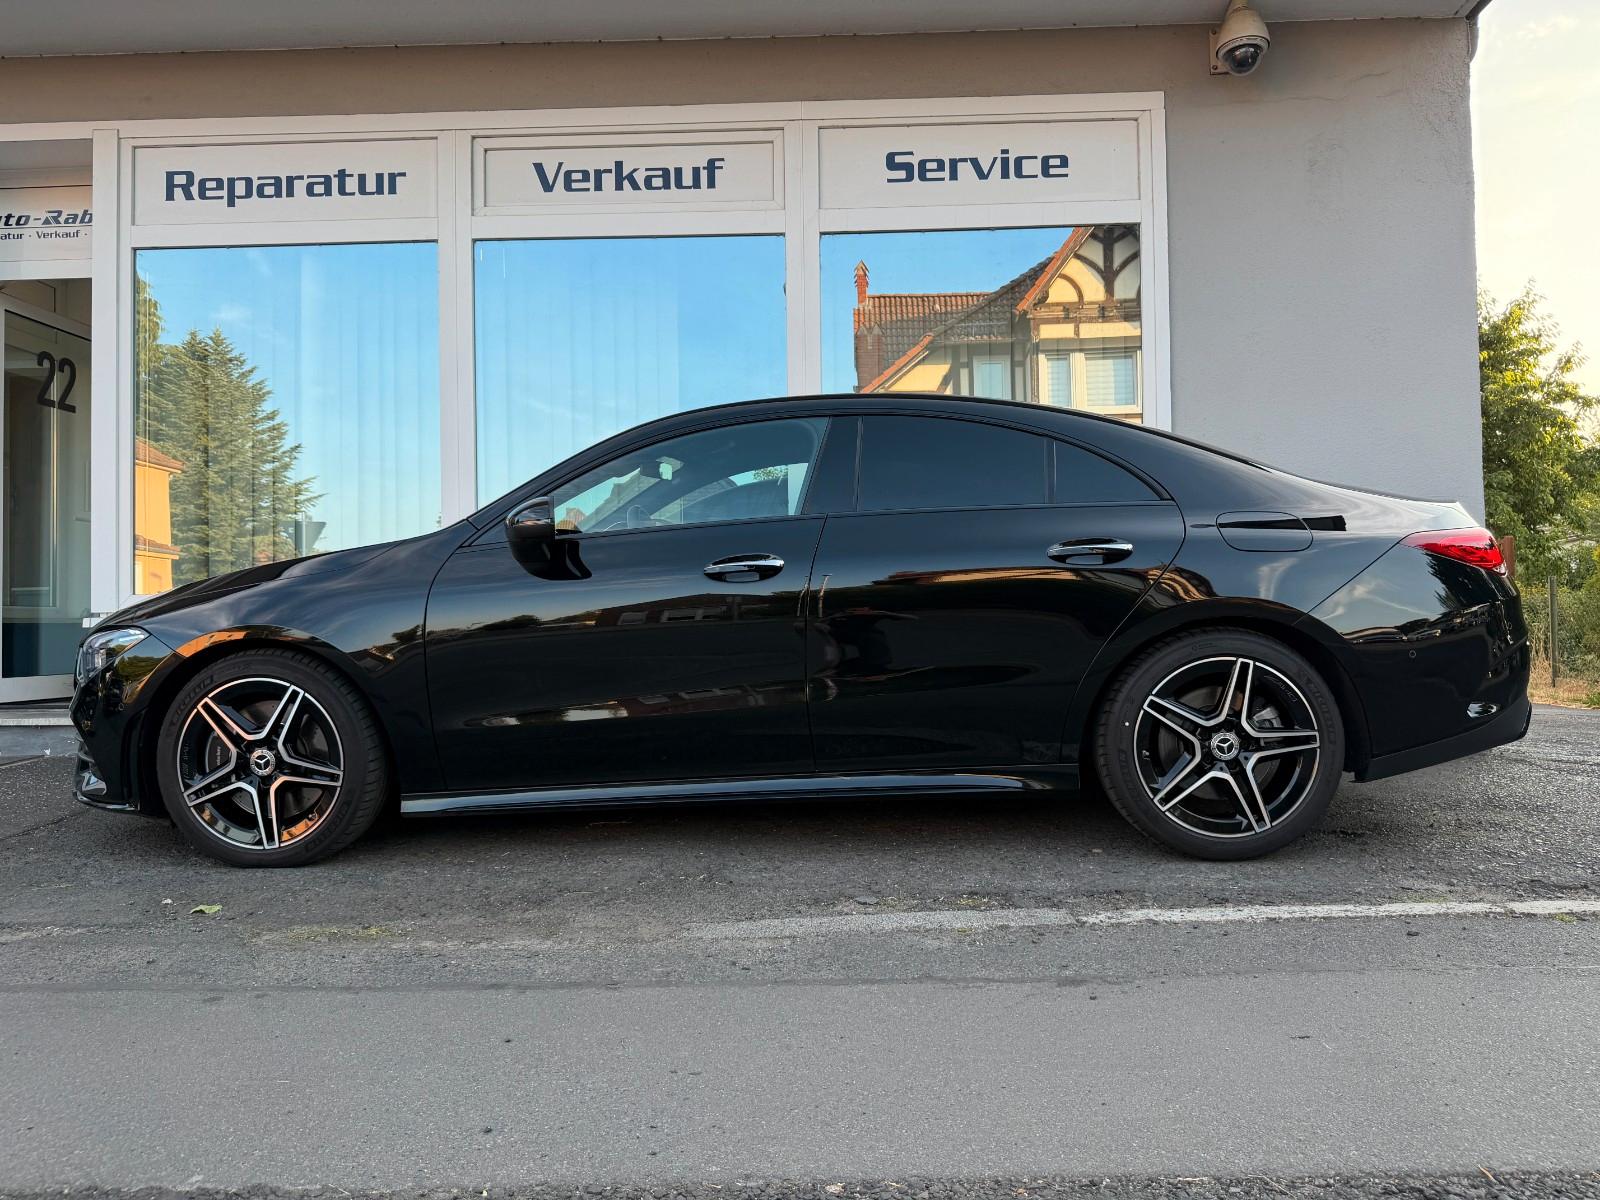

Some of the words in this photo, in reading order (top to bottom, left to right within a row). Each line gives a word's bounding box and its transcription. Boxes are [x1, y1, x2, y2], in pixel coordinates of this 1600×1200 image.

[532, 157, 725, 193] Verkauf
[885, 149, 1069, 184] Service
[165, 168, 407, 208] Reparatur
[0, 209, 93, 226] to-Rab
[36, 229, 81, 239] Verkauf
[36, 350, 77, 414] 22
